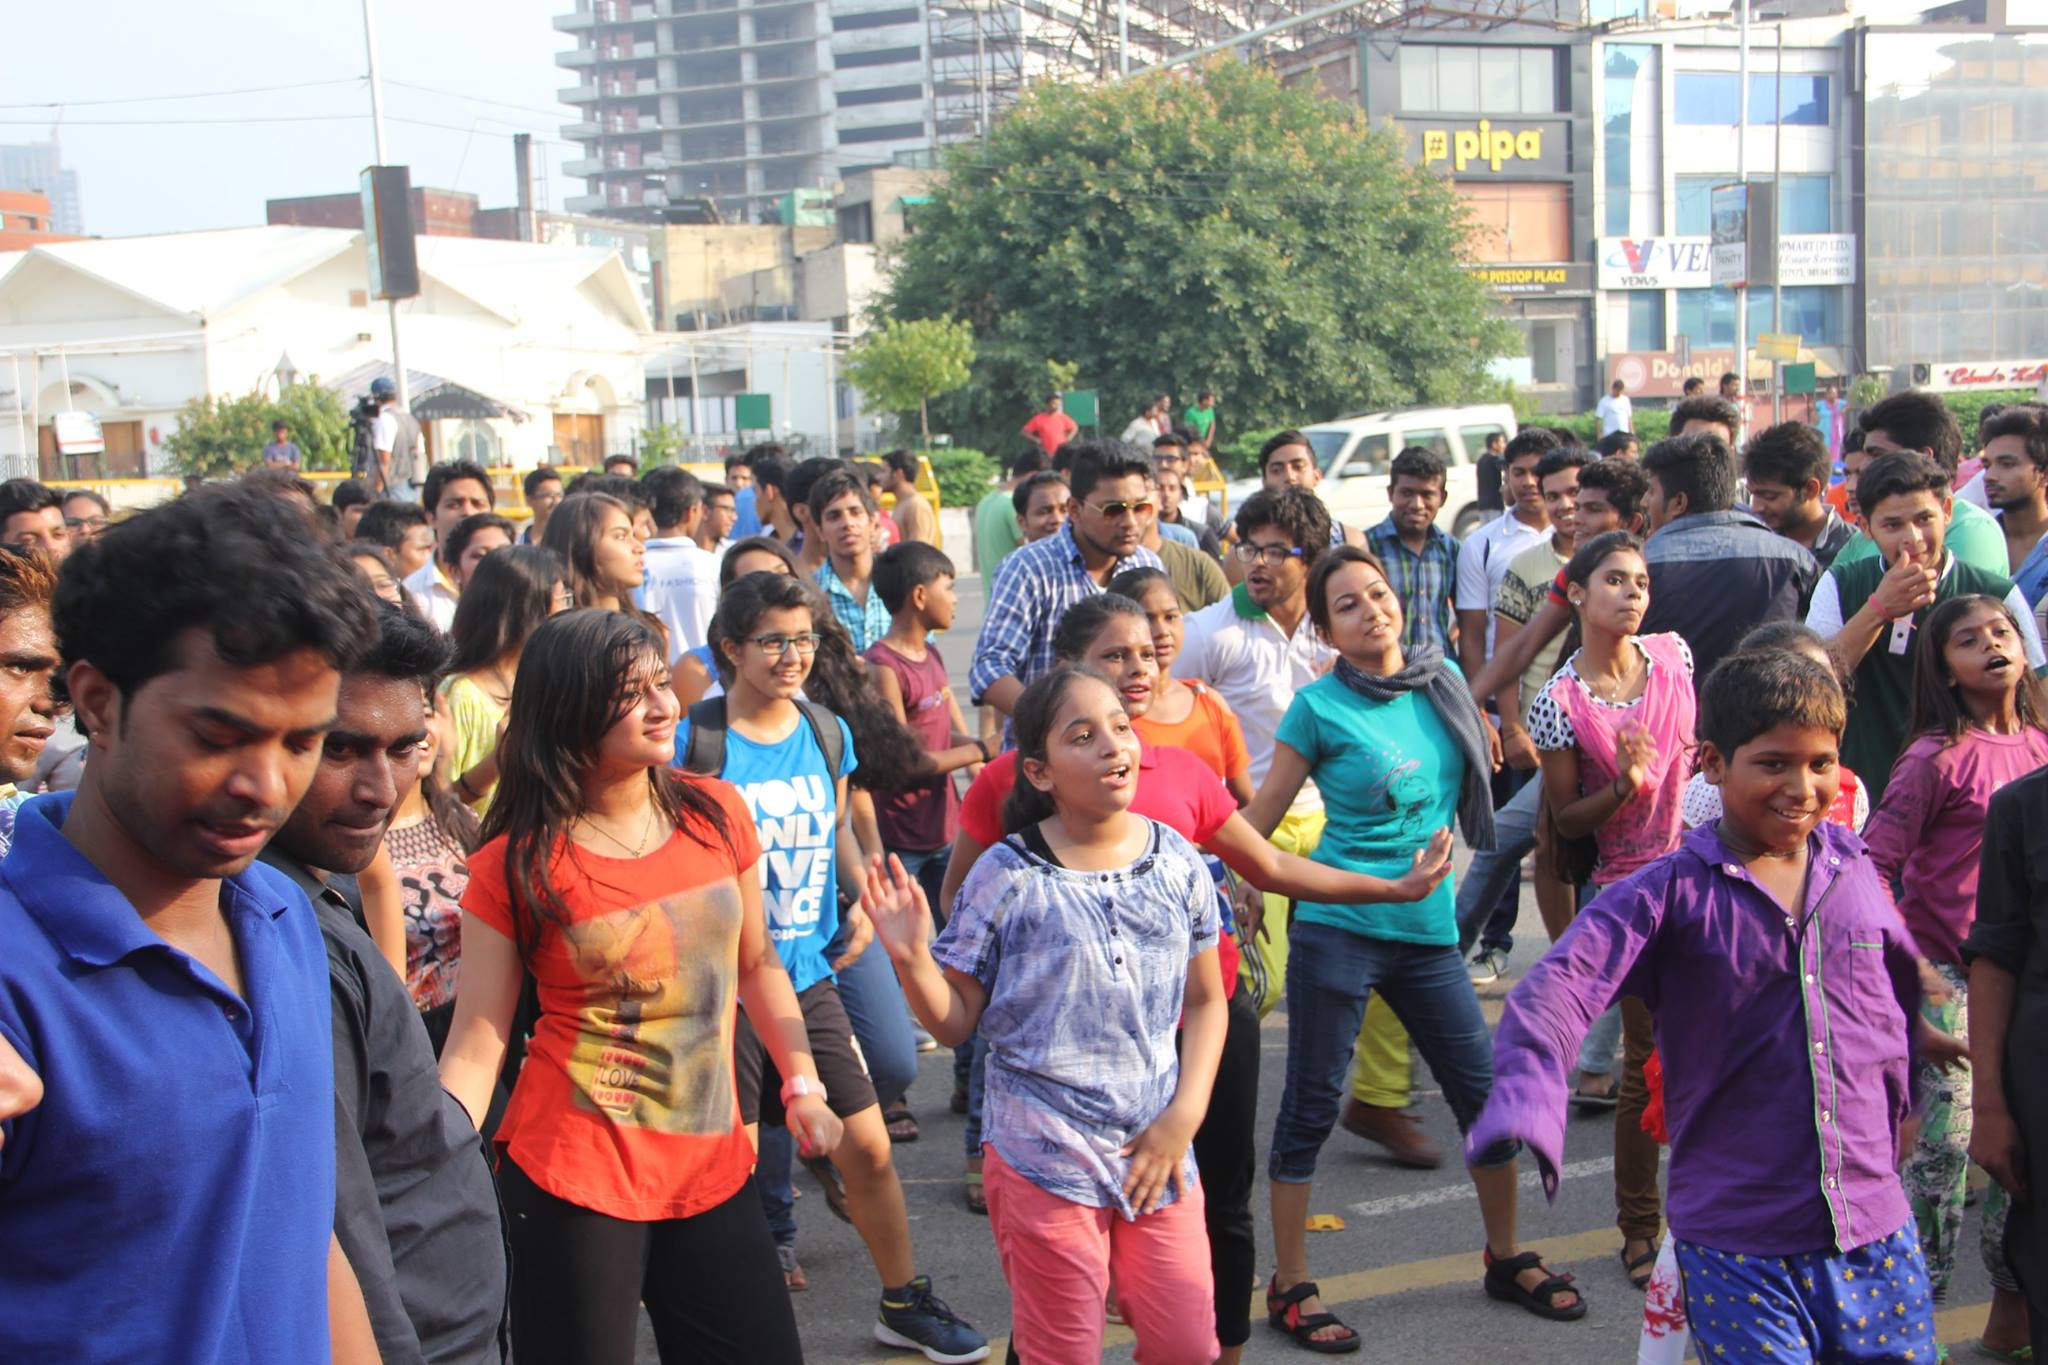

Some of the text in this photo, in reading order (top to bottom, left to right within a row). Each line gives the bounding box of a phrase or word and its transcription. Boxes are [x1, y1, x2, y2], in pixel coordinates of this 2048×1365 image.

[1455, 119, 1540, 171] pipa
[1490, 269, 1532, 283] PITSTOP
[1534, 268, 1567, 282] PLACE
[1621, 276, 1658, 287] VENUS
[735, 775, 826, 821] YOU
[756, 811, 835, 853] NLY
[758, 848, 832, 890] IVE
[762, 887, 823, 927] NCE
